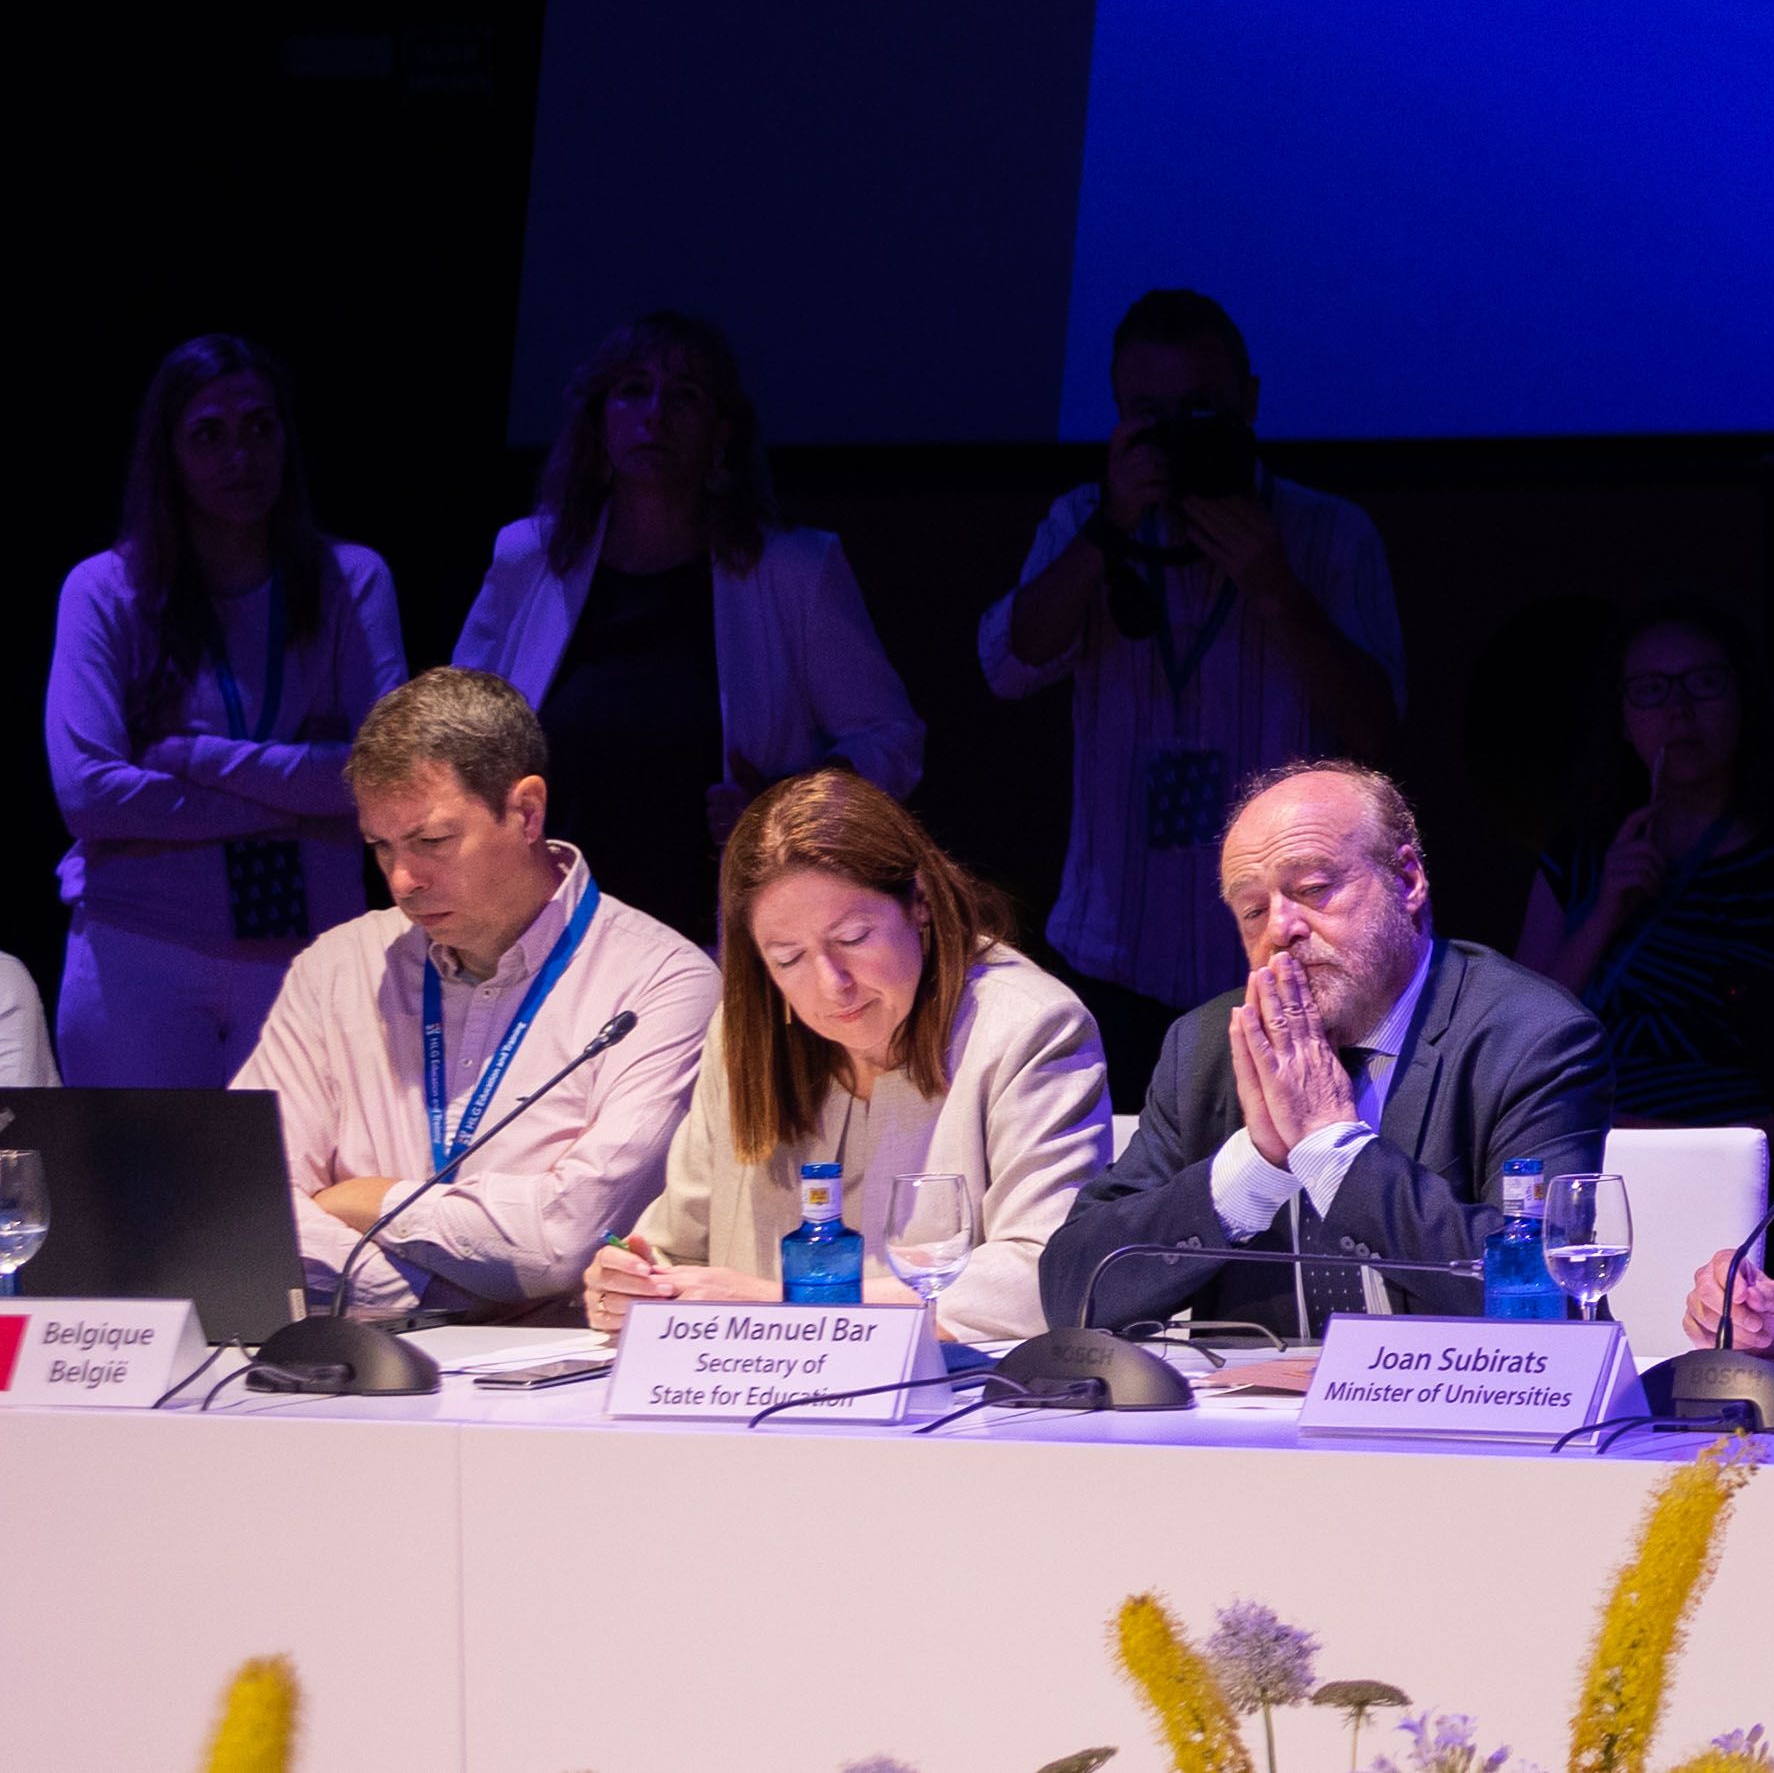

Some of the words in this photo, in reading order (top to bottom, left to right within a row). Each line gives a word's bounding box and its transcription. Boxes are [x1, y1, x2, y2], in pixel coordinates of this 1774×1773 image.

[42, 1321, 155, 1351] Belgique
[659, 1315, 719, 1341] José
[724, 1316, 827, 1342] Manuel
[831, 1317, 878, 1343] Bar
[695, 1353, 798, 1378] Secretary
[803, 1353, 828, 1374] of
[1368, 1346, 1431, 1371] Joan
[1437, 1347, 1549, 1374] Subirats
[49, 1360, 129, 1389] België
[649, 1384, 708, 1406] State
[710, 1385, 741, 1406] for
[1324, 1381, 1414, 1403] Minister
[1417, 1382, 1445, 1404] of
[1445, 1384, 1573, 1408] Universities
